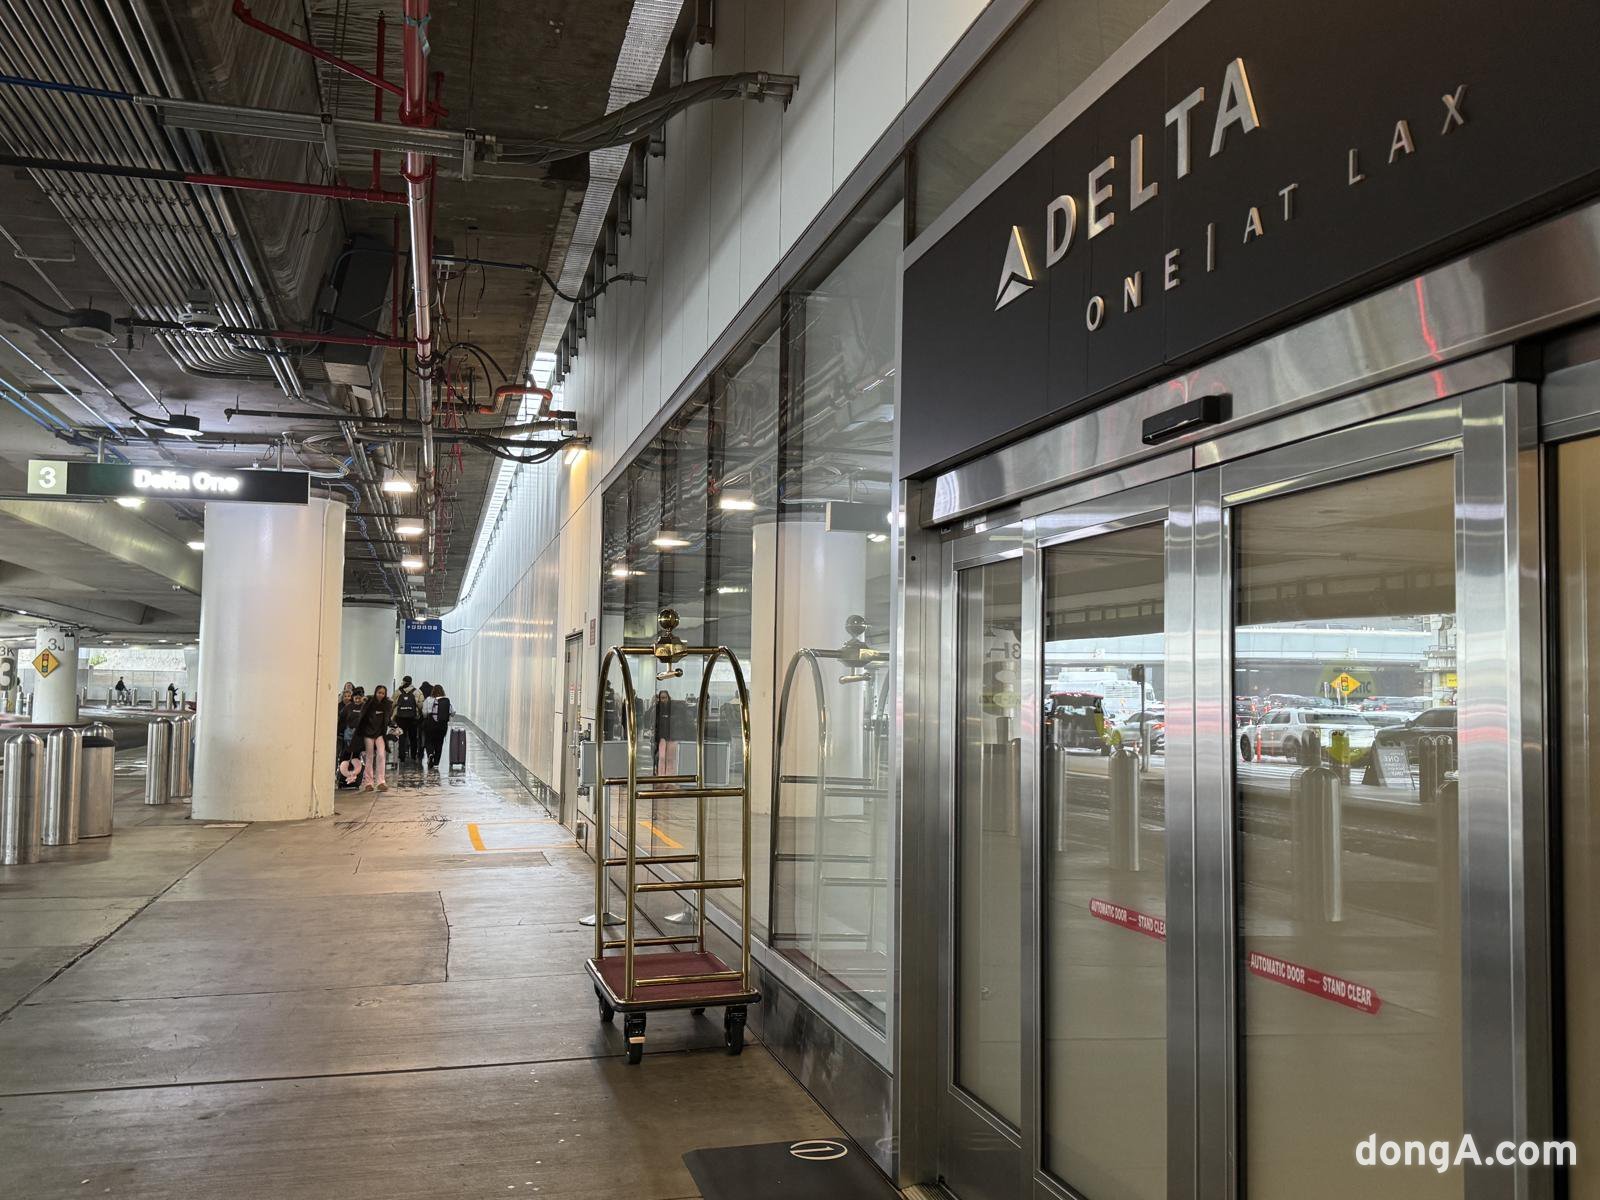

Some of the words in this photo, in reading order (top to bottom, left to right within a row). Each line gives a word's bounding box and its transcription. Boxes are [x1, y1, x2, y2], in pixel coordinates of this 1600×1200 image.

[1046, 57, 1260, 268] DELTA
[1086, 248, 1181, 332] ONE
[1243, 183, 1299, 244] AT
[1349, 84, 1468, 186] LAX
[38, 467, 57, 489] 3
[133, 468, 190, 490] Delta
[192, 471, 240, 492] One
[1091, 900, 1115, 918] AUTOMATIC
[1115, 907, 1128, 922] DOOR
[1138, 914, 1154, 931] STAND
[1154, 920, 1167, 936] CLEA
[1250, 953, 1286, 978] AUTOMATIC
[1286, 965, 1305, 985] DOOR
[1322, 975, 1346, 997] STAND
[1347, 984, 1372, 1006] CLEAR
